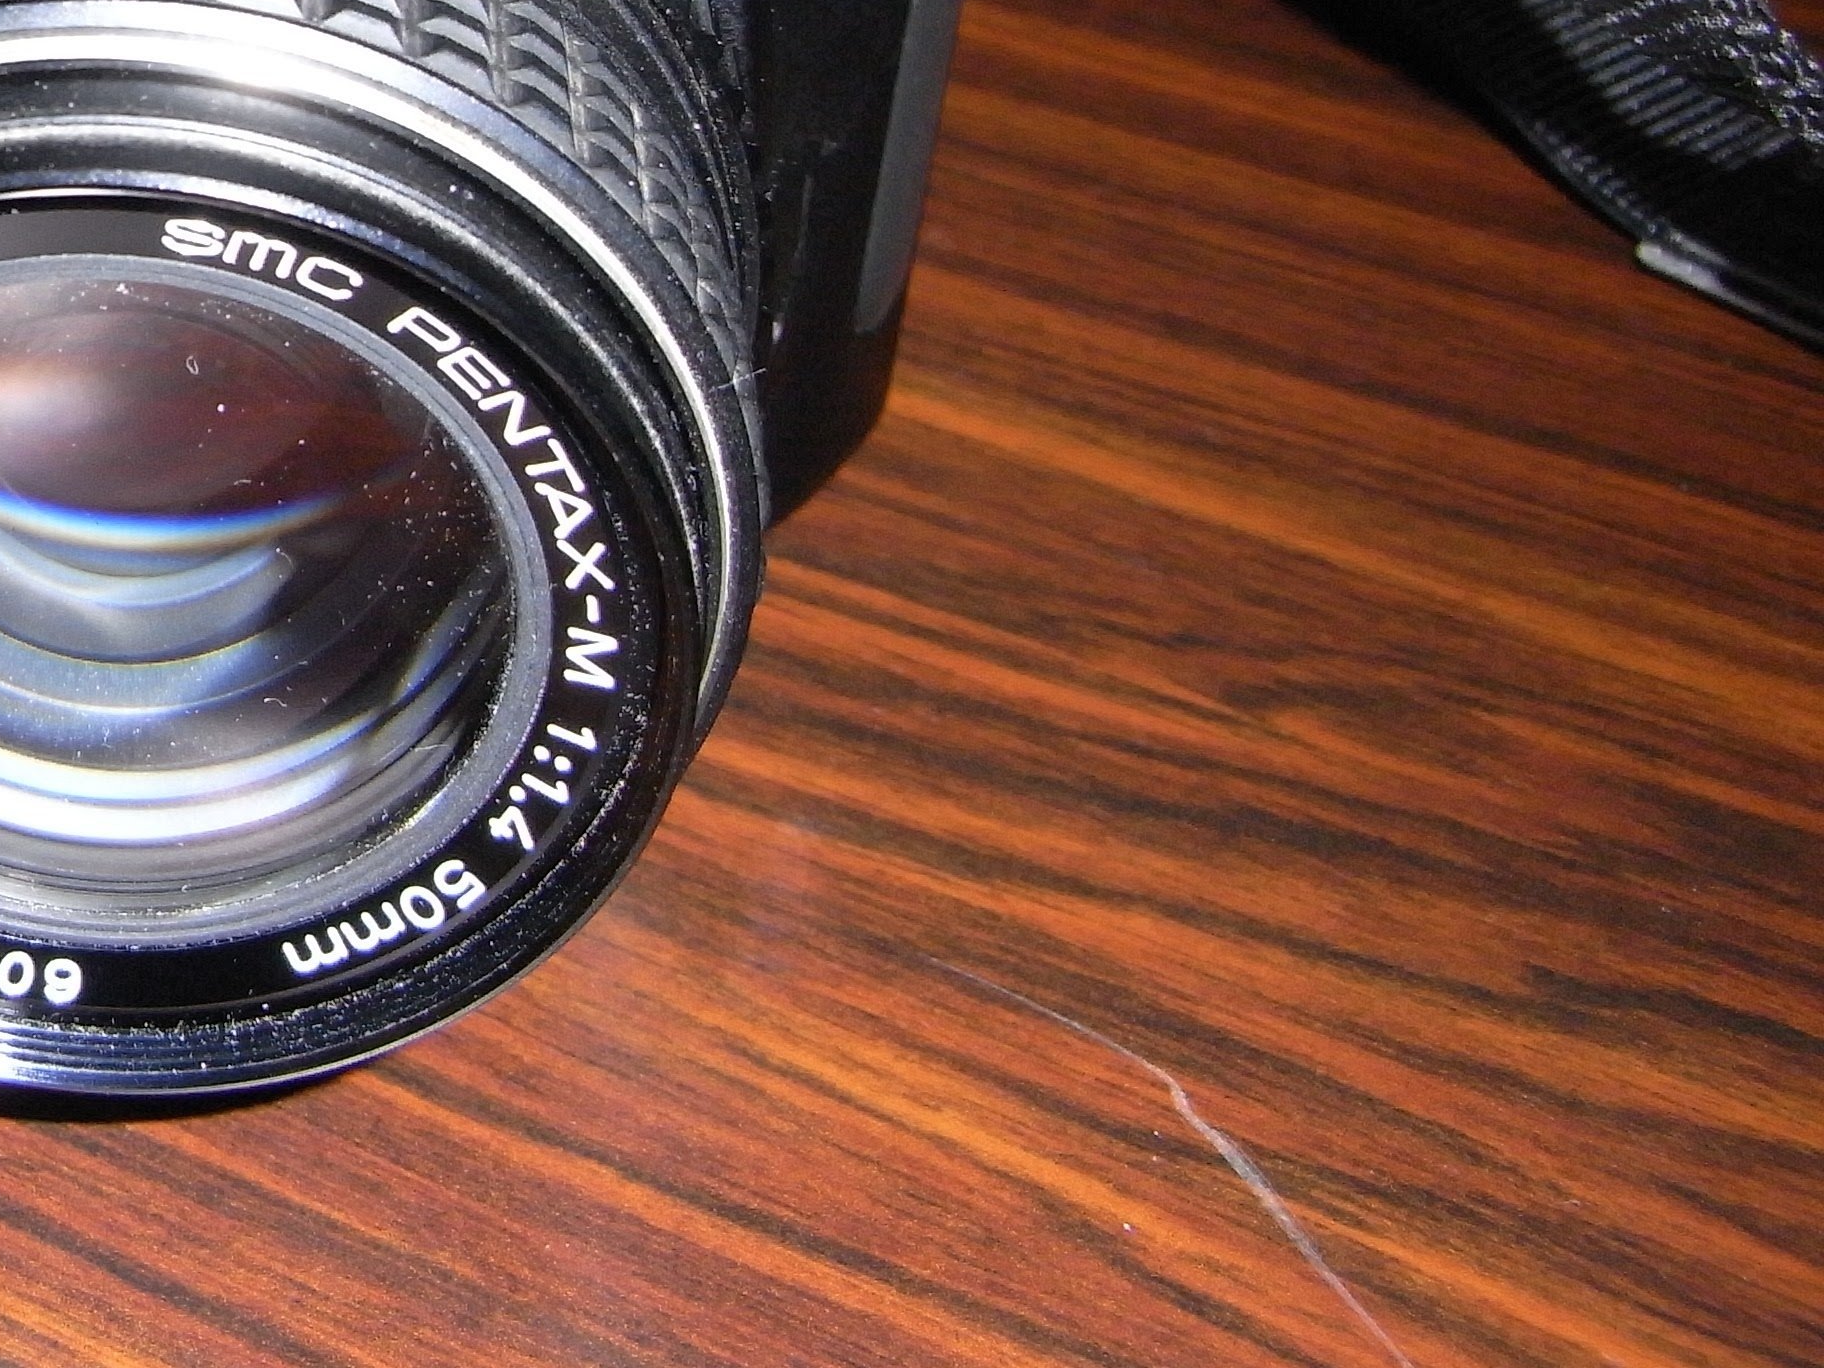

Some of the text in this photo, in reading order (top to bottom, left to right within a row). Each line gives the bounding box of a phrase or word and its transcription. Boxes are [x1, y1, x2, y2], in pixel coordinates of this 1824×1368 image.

[161, 217, 621, 976] smc PENTAX-M 1:1.4 50mm
